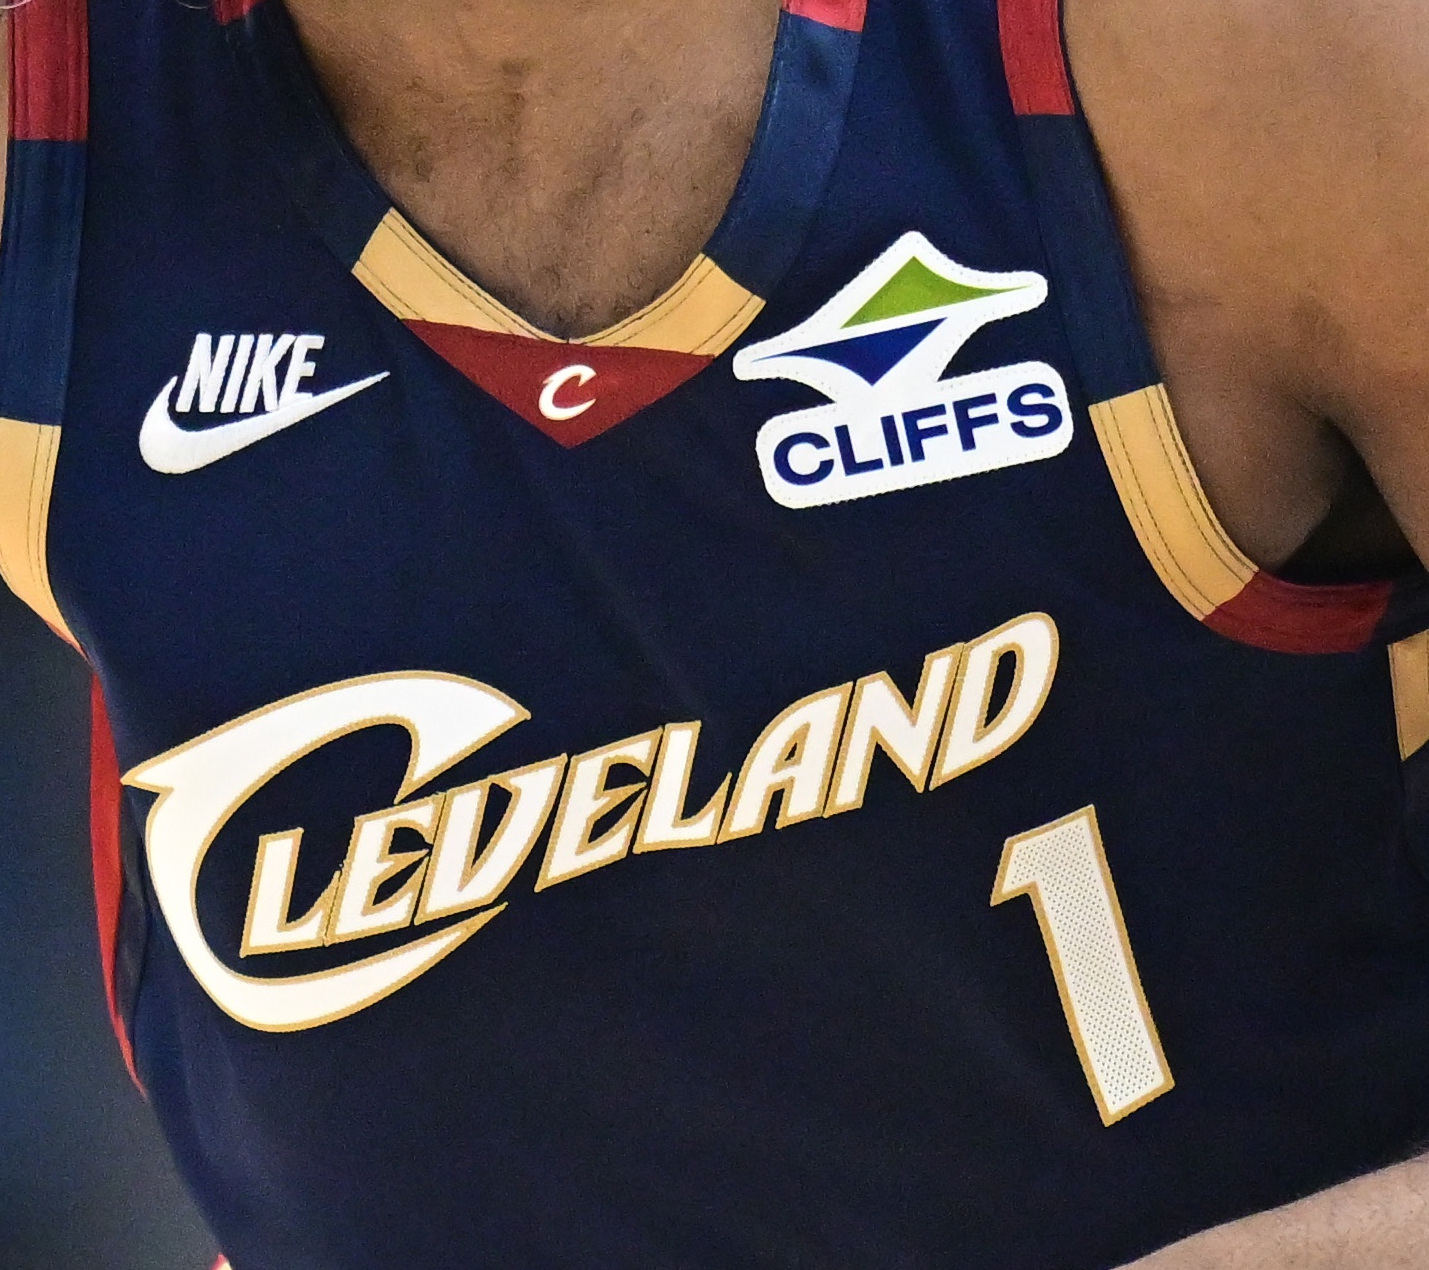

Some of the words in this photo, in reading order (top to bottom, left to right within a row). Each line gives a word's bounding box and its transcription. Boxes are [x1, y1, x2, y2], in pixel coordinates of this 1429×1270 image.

[175, 332, 325, 413] NIKE
[538, 364, 597, 421] C
[772, 382, 1064, 486] CLIFFS
[121, 611, 1060, 1033] CLEVELAND
[990, 804, 1175, 1127] 1
